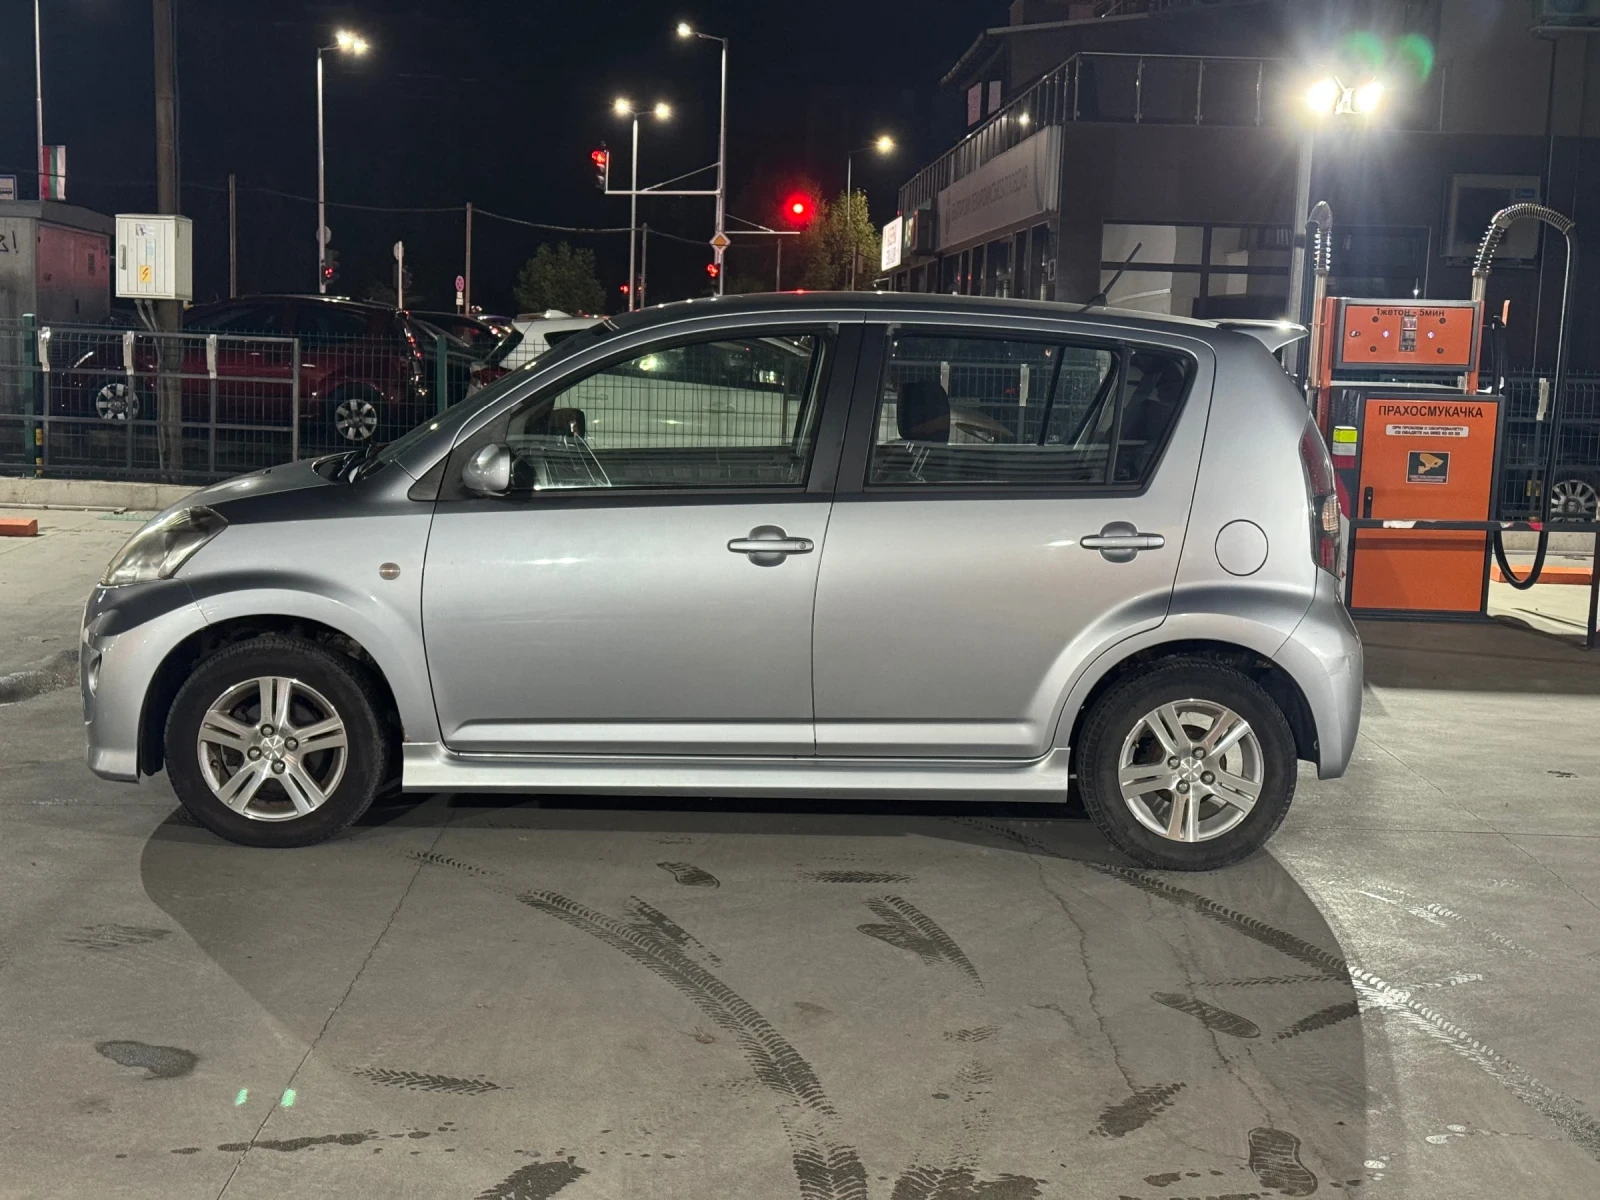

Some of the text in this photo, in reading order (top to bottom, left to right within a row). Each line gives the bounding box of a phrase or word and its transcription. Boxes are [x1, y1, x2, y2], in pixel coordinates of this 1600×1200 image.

[1376, 307, 1410, 317] 1жетон
[1419, 308, 1445, 317] 5мин
[1378, 405, 1483, 418] ПРАХОСМУКАЧКА
